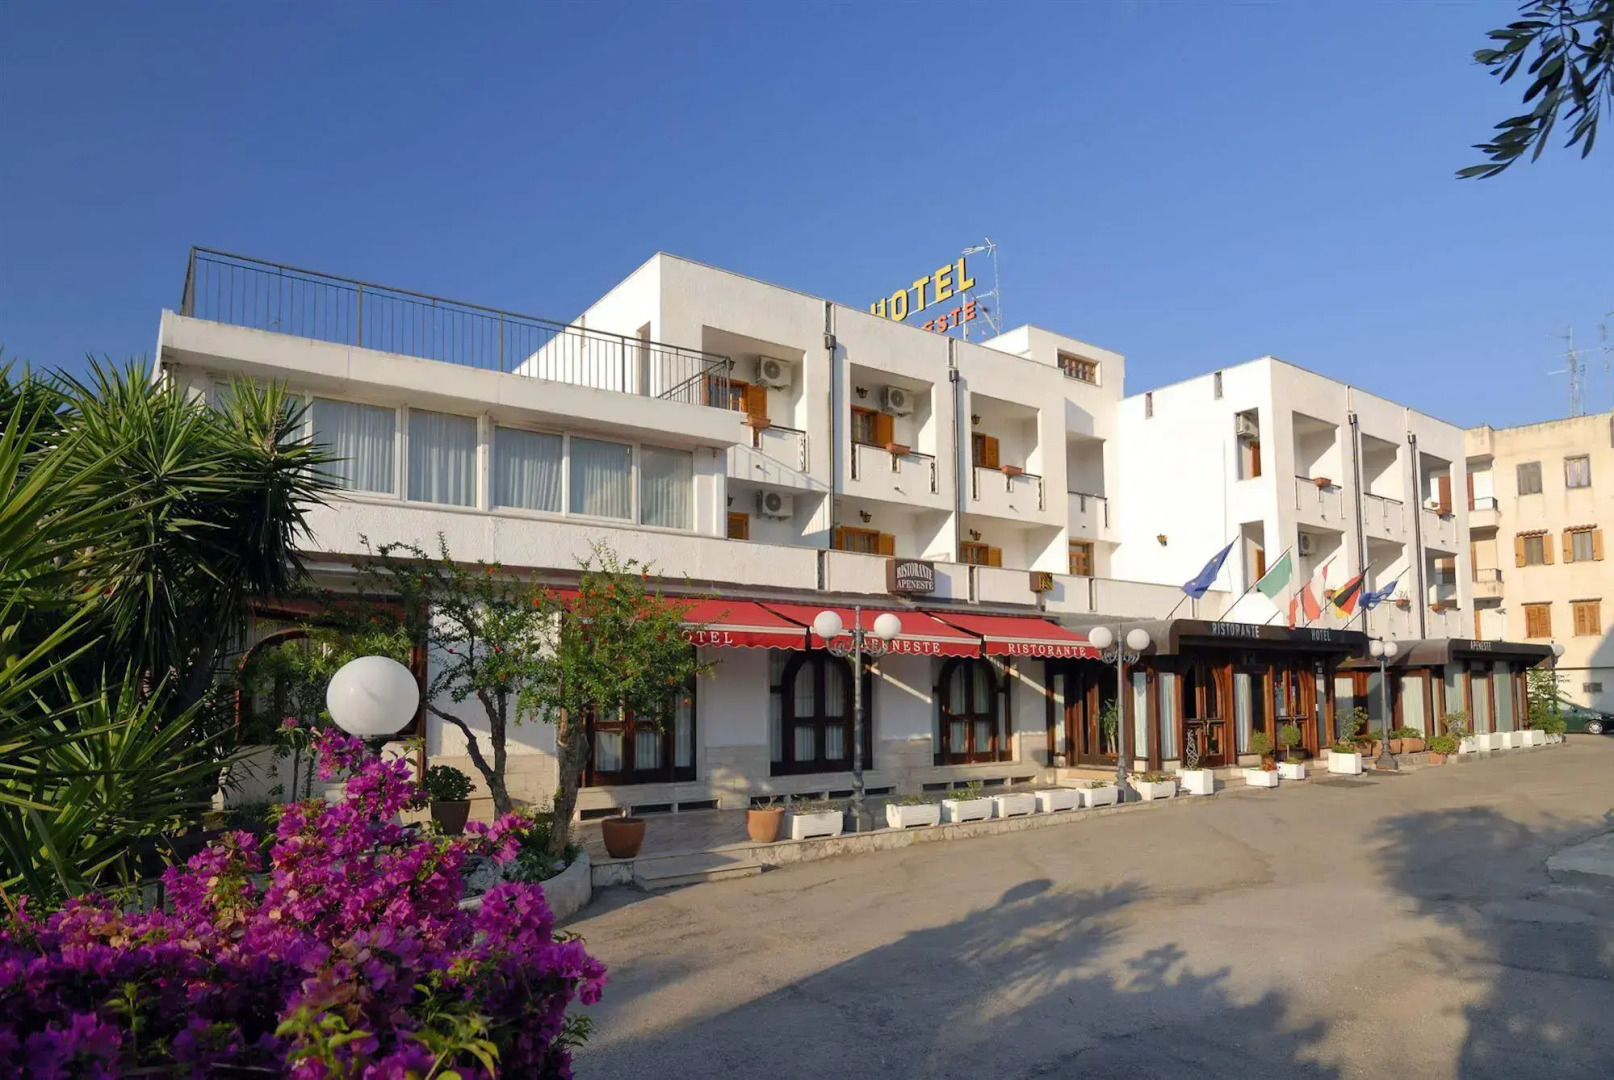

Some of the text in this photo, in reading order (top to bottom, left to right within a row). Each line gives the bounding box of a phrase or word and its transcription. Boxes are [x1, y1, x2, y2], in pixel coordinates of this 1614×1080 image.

[871, 258, 975, 321] HOTEL
[896, 562, 934, 580] RISTORANTE
[896, 579, 934, 590] APENESTE
[681, 629, 733, 644] OTEL
[1211, 622, 1260, 638] RISTORANTE
[1311, 629, 1331, 642] HOTEL
[1008, 643, 1086, 656] RISTORANTE
